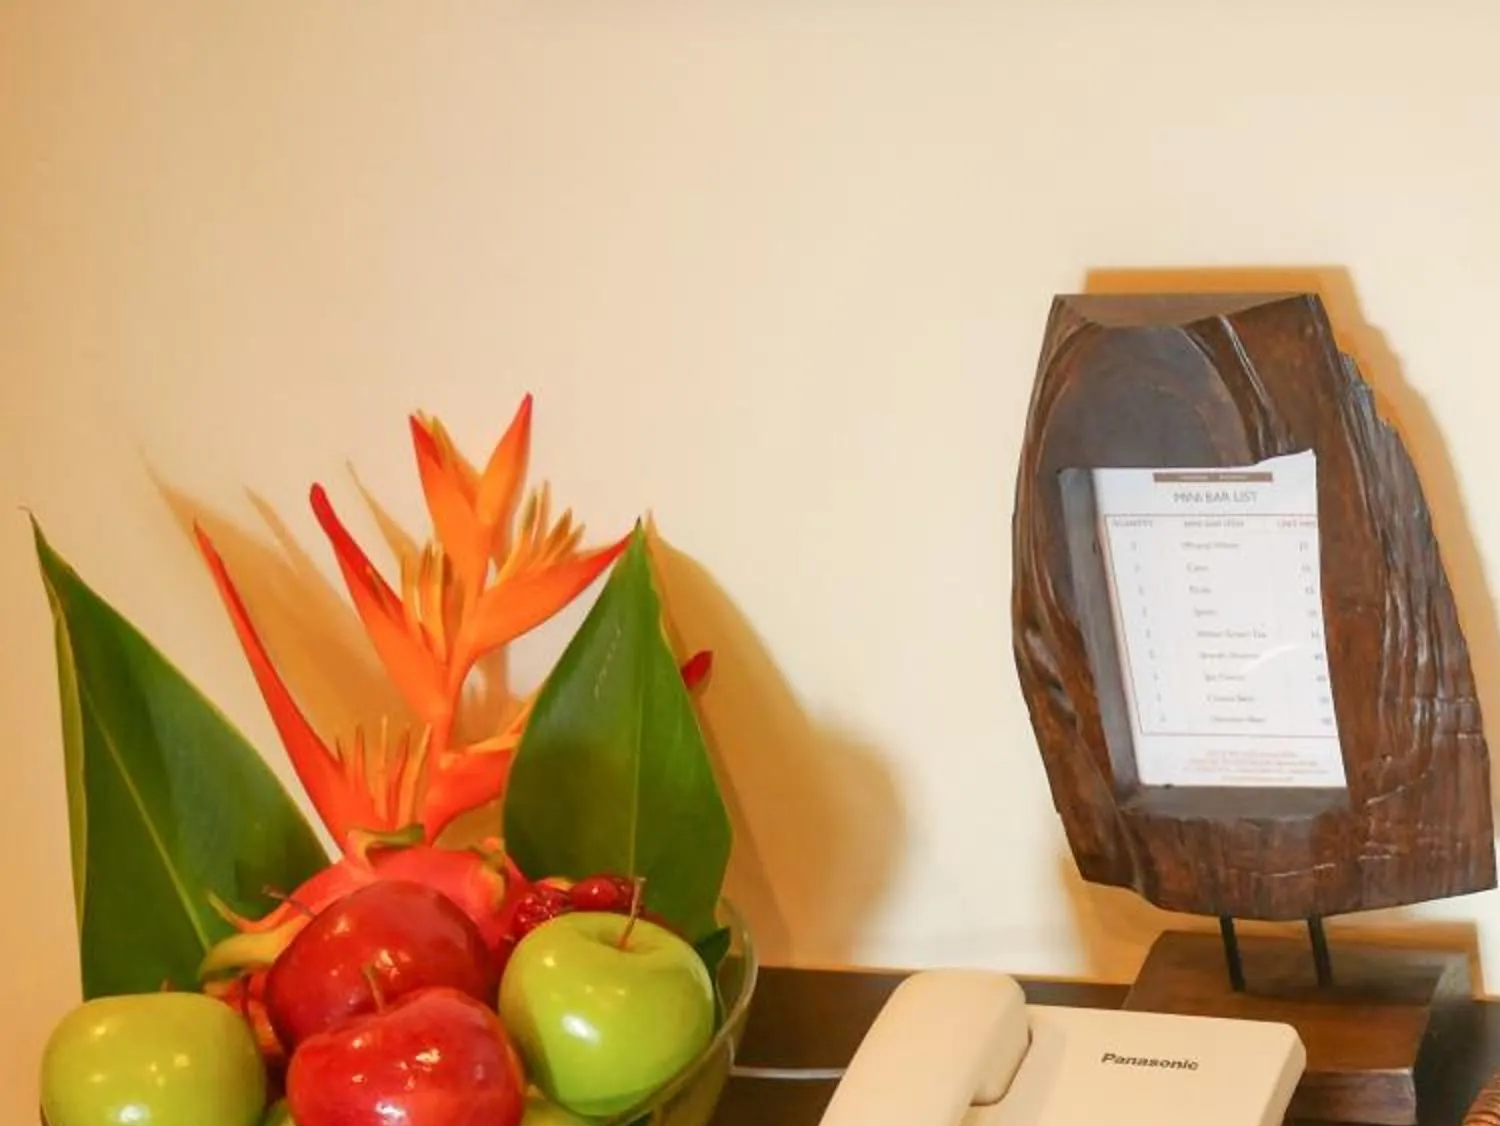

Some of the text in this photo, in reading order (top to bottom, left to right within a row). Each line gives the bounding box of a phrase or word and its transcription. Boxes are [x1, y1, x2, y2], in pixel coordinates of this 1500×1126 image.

[1205, 491, 1230, 503] BAR
[1233, 490, 1257, 503] LIST
[1101, 1053, 1199, 1071] Panasonic
